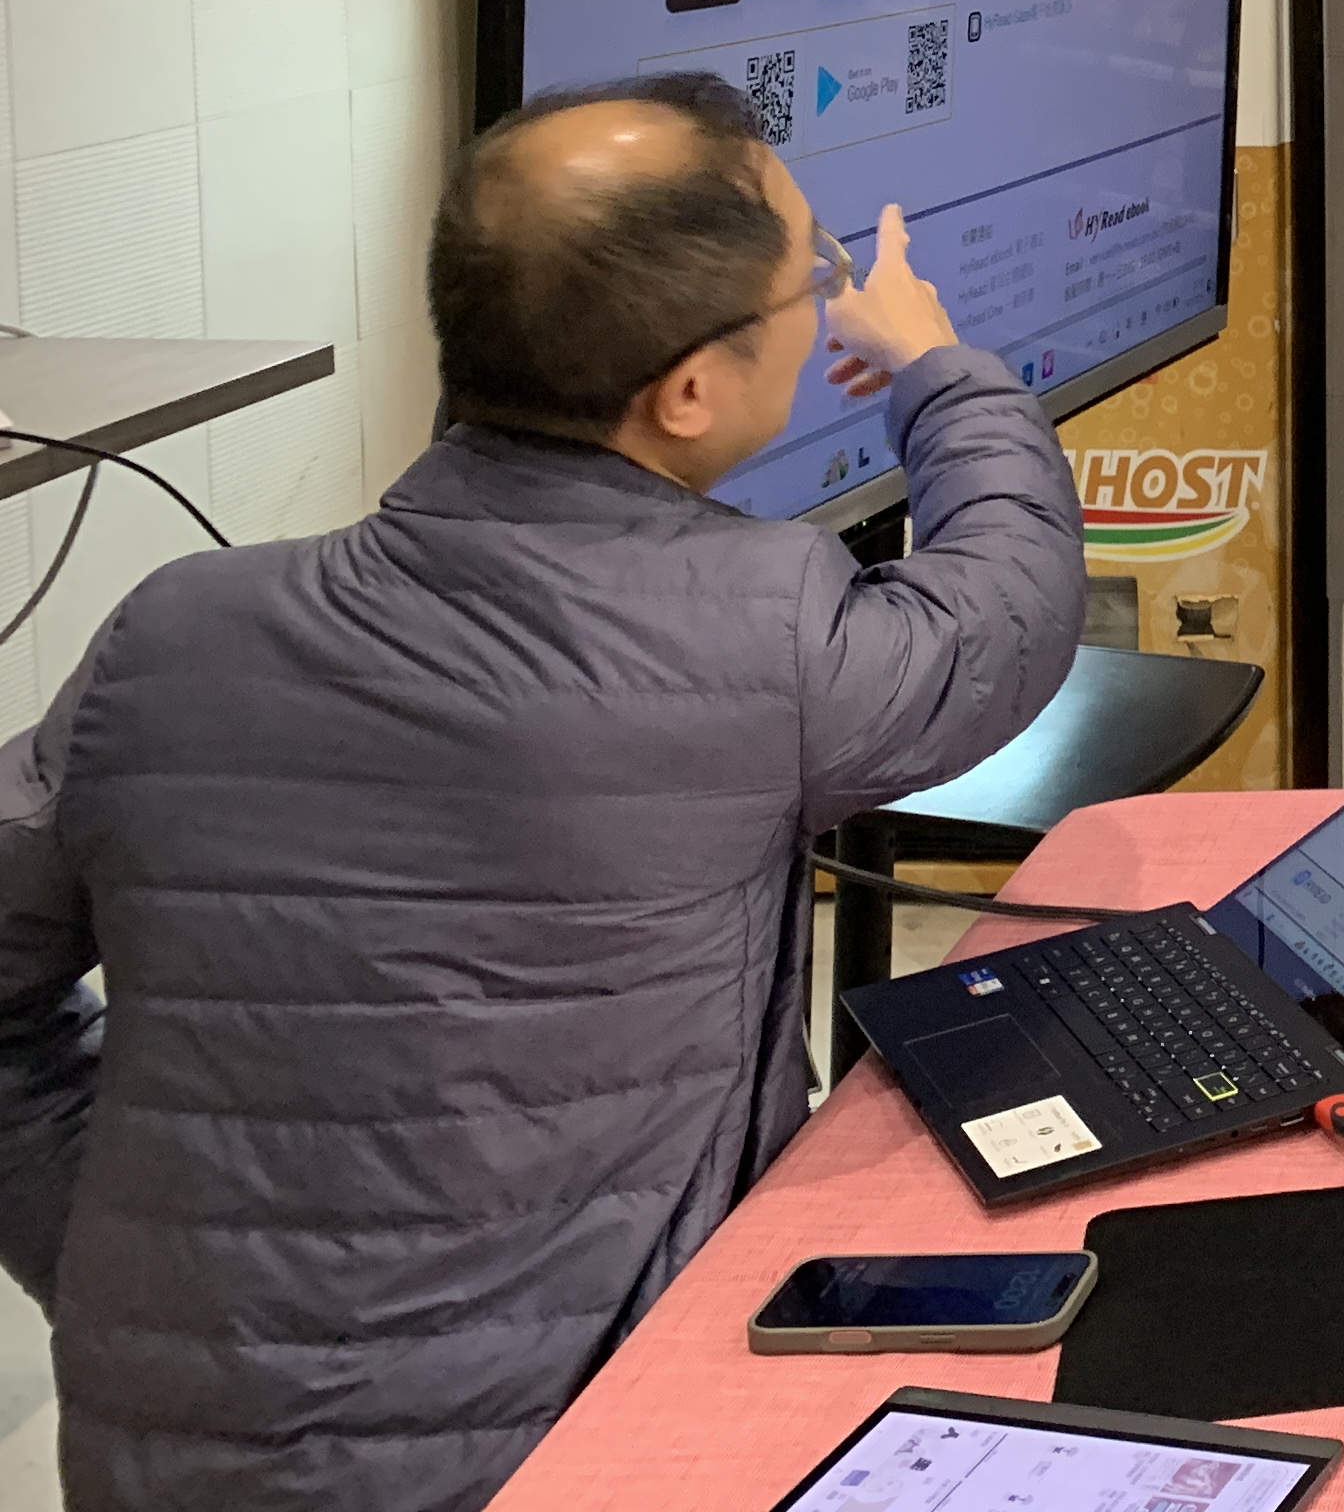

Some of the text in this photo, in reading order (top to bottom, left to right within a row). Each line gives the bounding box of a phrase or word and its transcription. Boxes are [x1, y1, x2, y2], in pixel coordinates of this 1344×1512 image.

[847, 76, 899, 102] Google Play
[1085, 206, 1125, 244] HyRead
[1083, 451, 1265, 509] HOST
